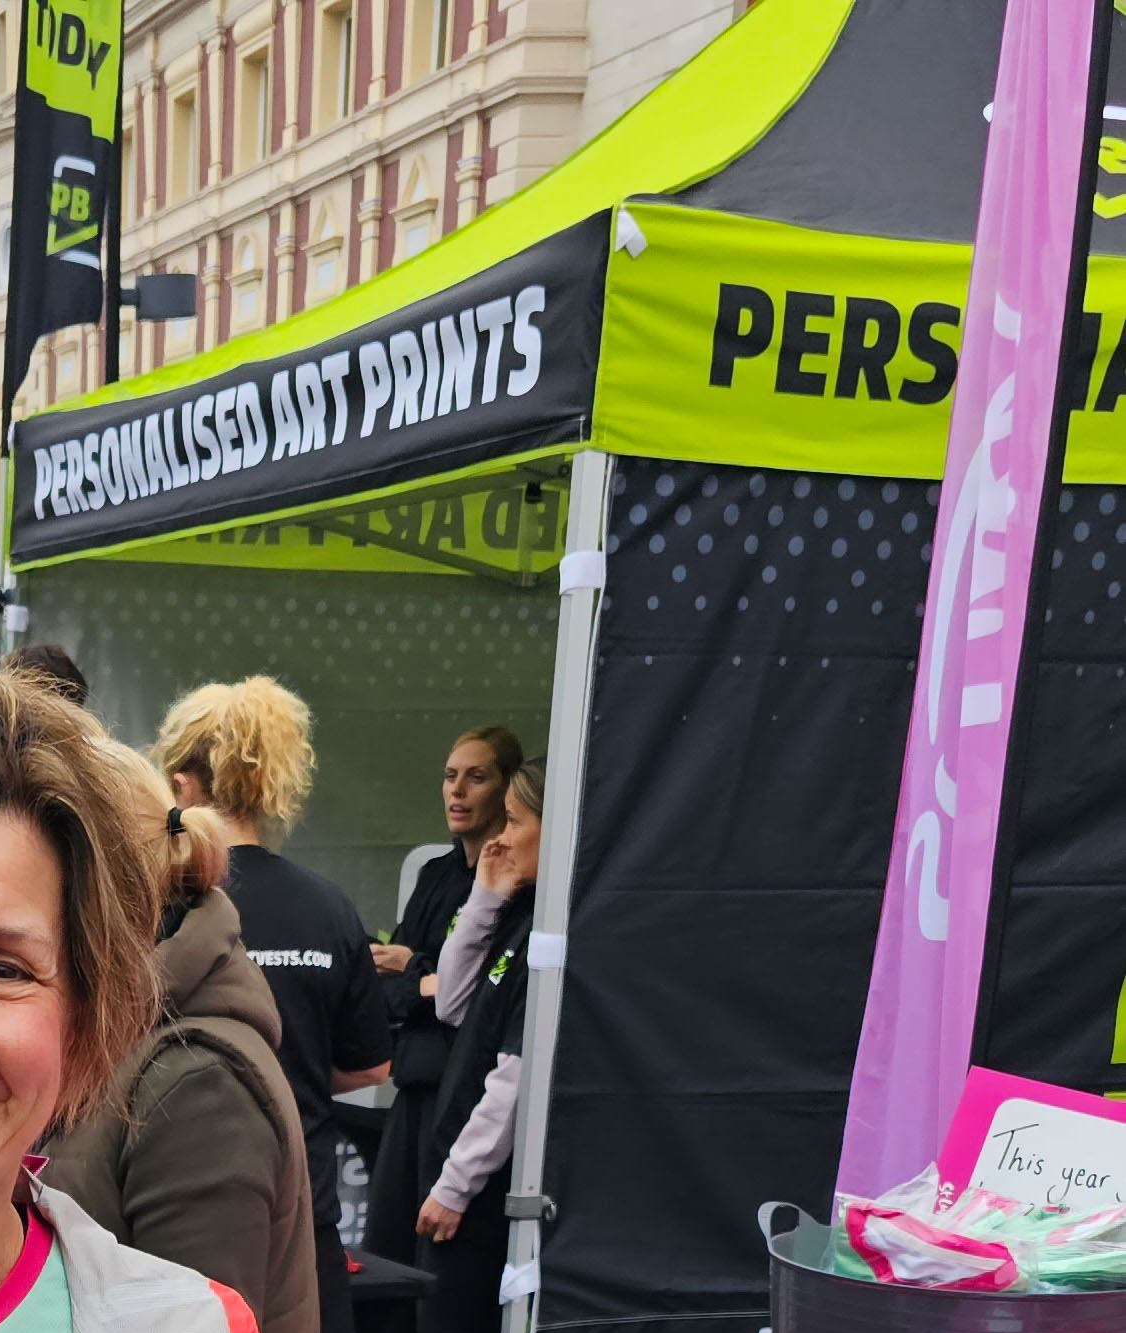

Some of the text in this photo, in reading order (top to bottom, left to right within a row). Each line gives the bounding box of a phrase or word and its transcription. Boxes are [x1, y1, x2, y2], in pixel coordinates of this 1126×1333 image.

[49, 181, 91, 222] PB
[34, 284, 547, 521] PERSONALISED ART PRINTS
[993, 1123, 1112, 1205] This year
